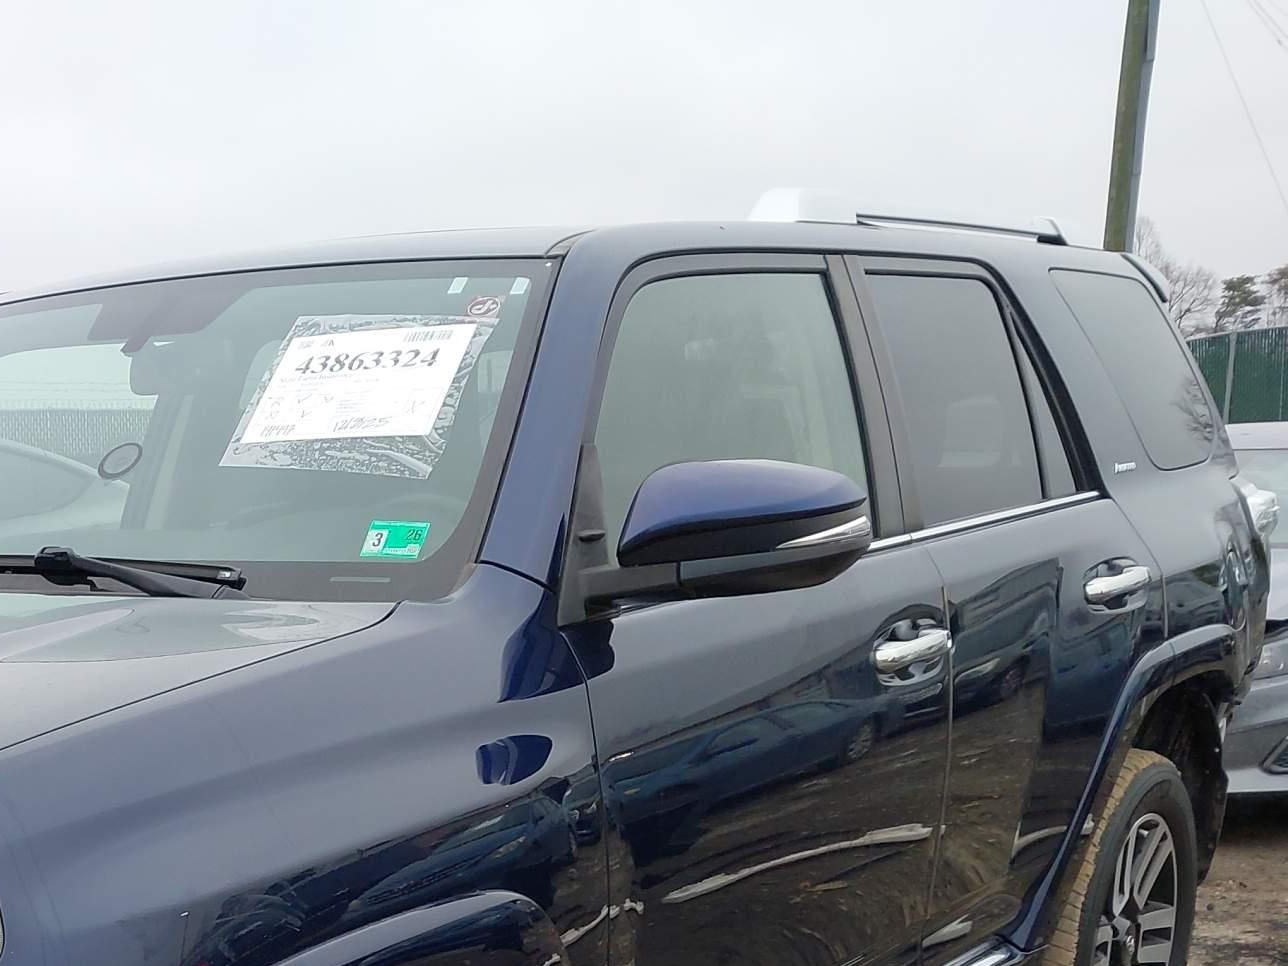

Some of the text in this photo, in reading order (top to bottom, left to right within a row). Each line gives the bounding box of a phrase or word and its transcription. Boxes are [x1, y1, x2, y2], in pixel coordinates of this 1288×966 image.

[295, 348, 440, 375] 43863324
[372, 532, 384, 547] 3
[406, 529, 423, 541] 26
